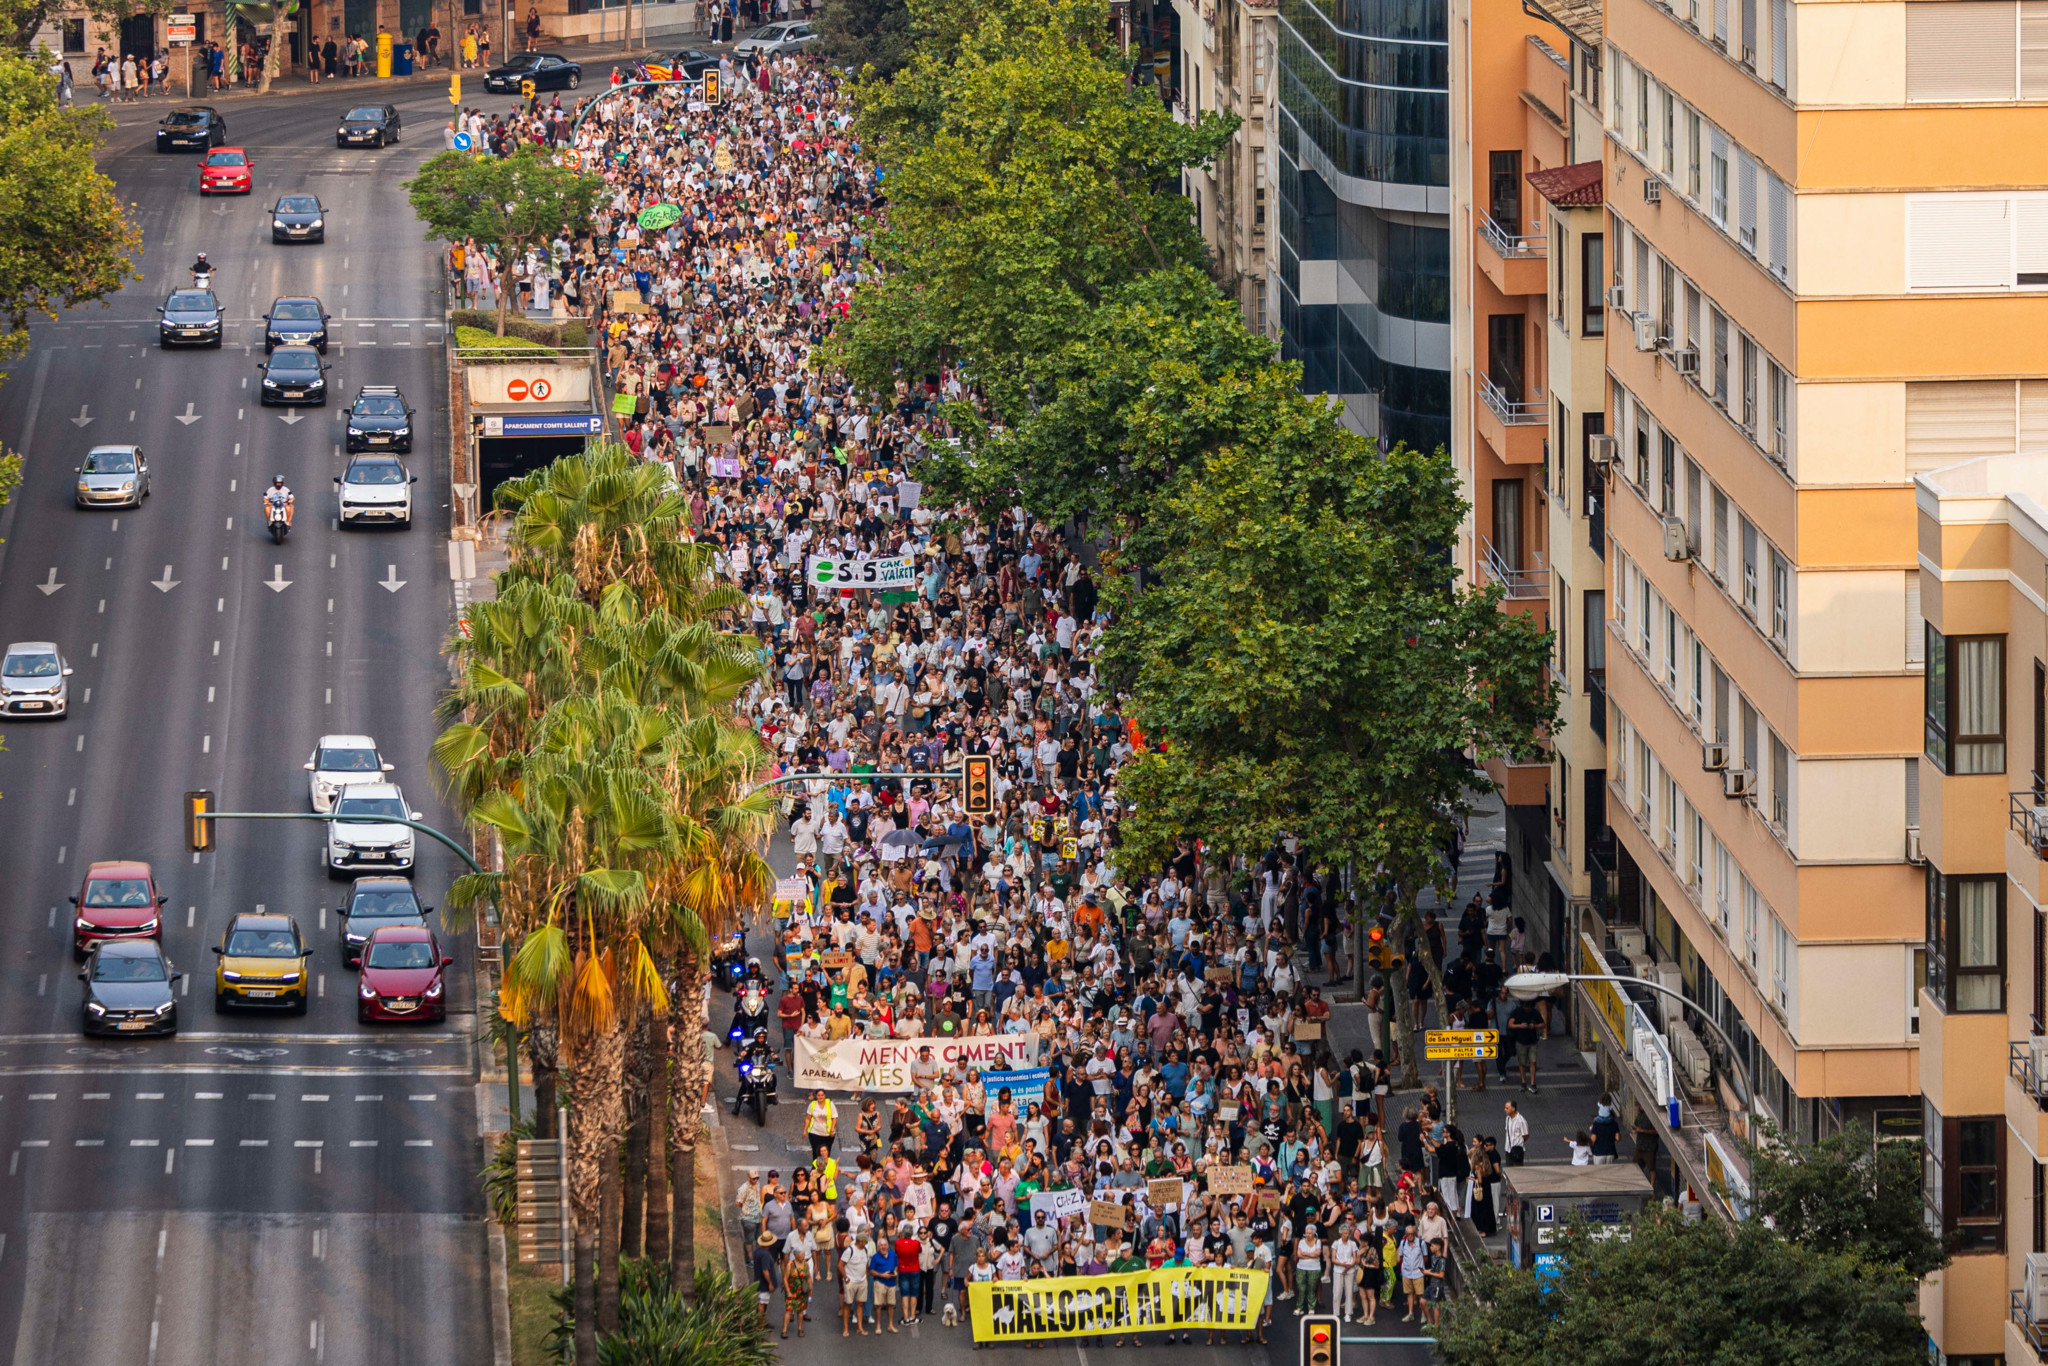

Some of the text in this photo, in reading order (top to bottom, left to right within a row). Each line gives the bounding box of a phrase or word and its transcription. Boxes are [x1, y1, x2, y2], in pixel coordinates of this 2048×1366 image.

[641, 211, 669, 223] FUCK
[644, 219, 664, 227] OFF
[590, 418, 602, 432] P
[1451, 1036, 1472, 1044] Miguel
[801, 1068, 843, 1080] APAEMA
[858, 1062, 904, 1087] MÉS
[1032, 1071, 1050, 1080] ecològic
[1540, 1207, 1550, 1220] P
[991, 1284, 1132, 1335] MALLORCA
[1137, 1281, 1166, 1326] AL
